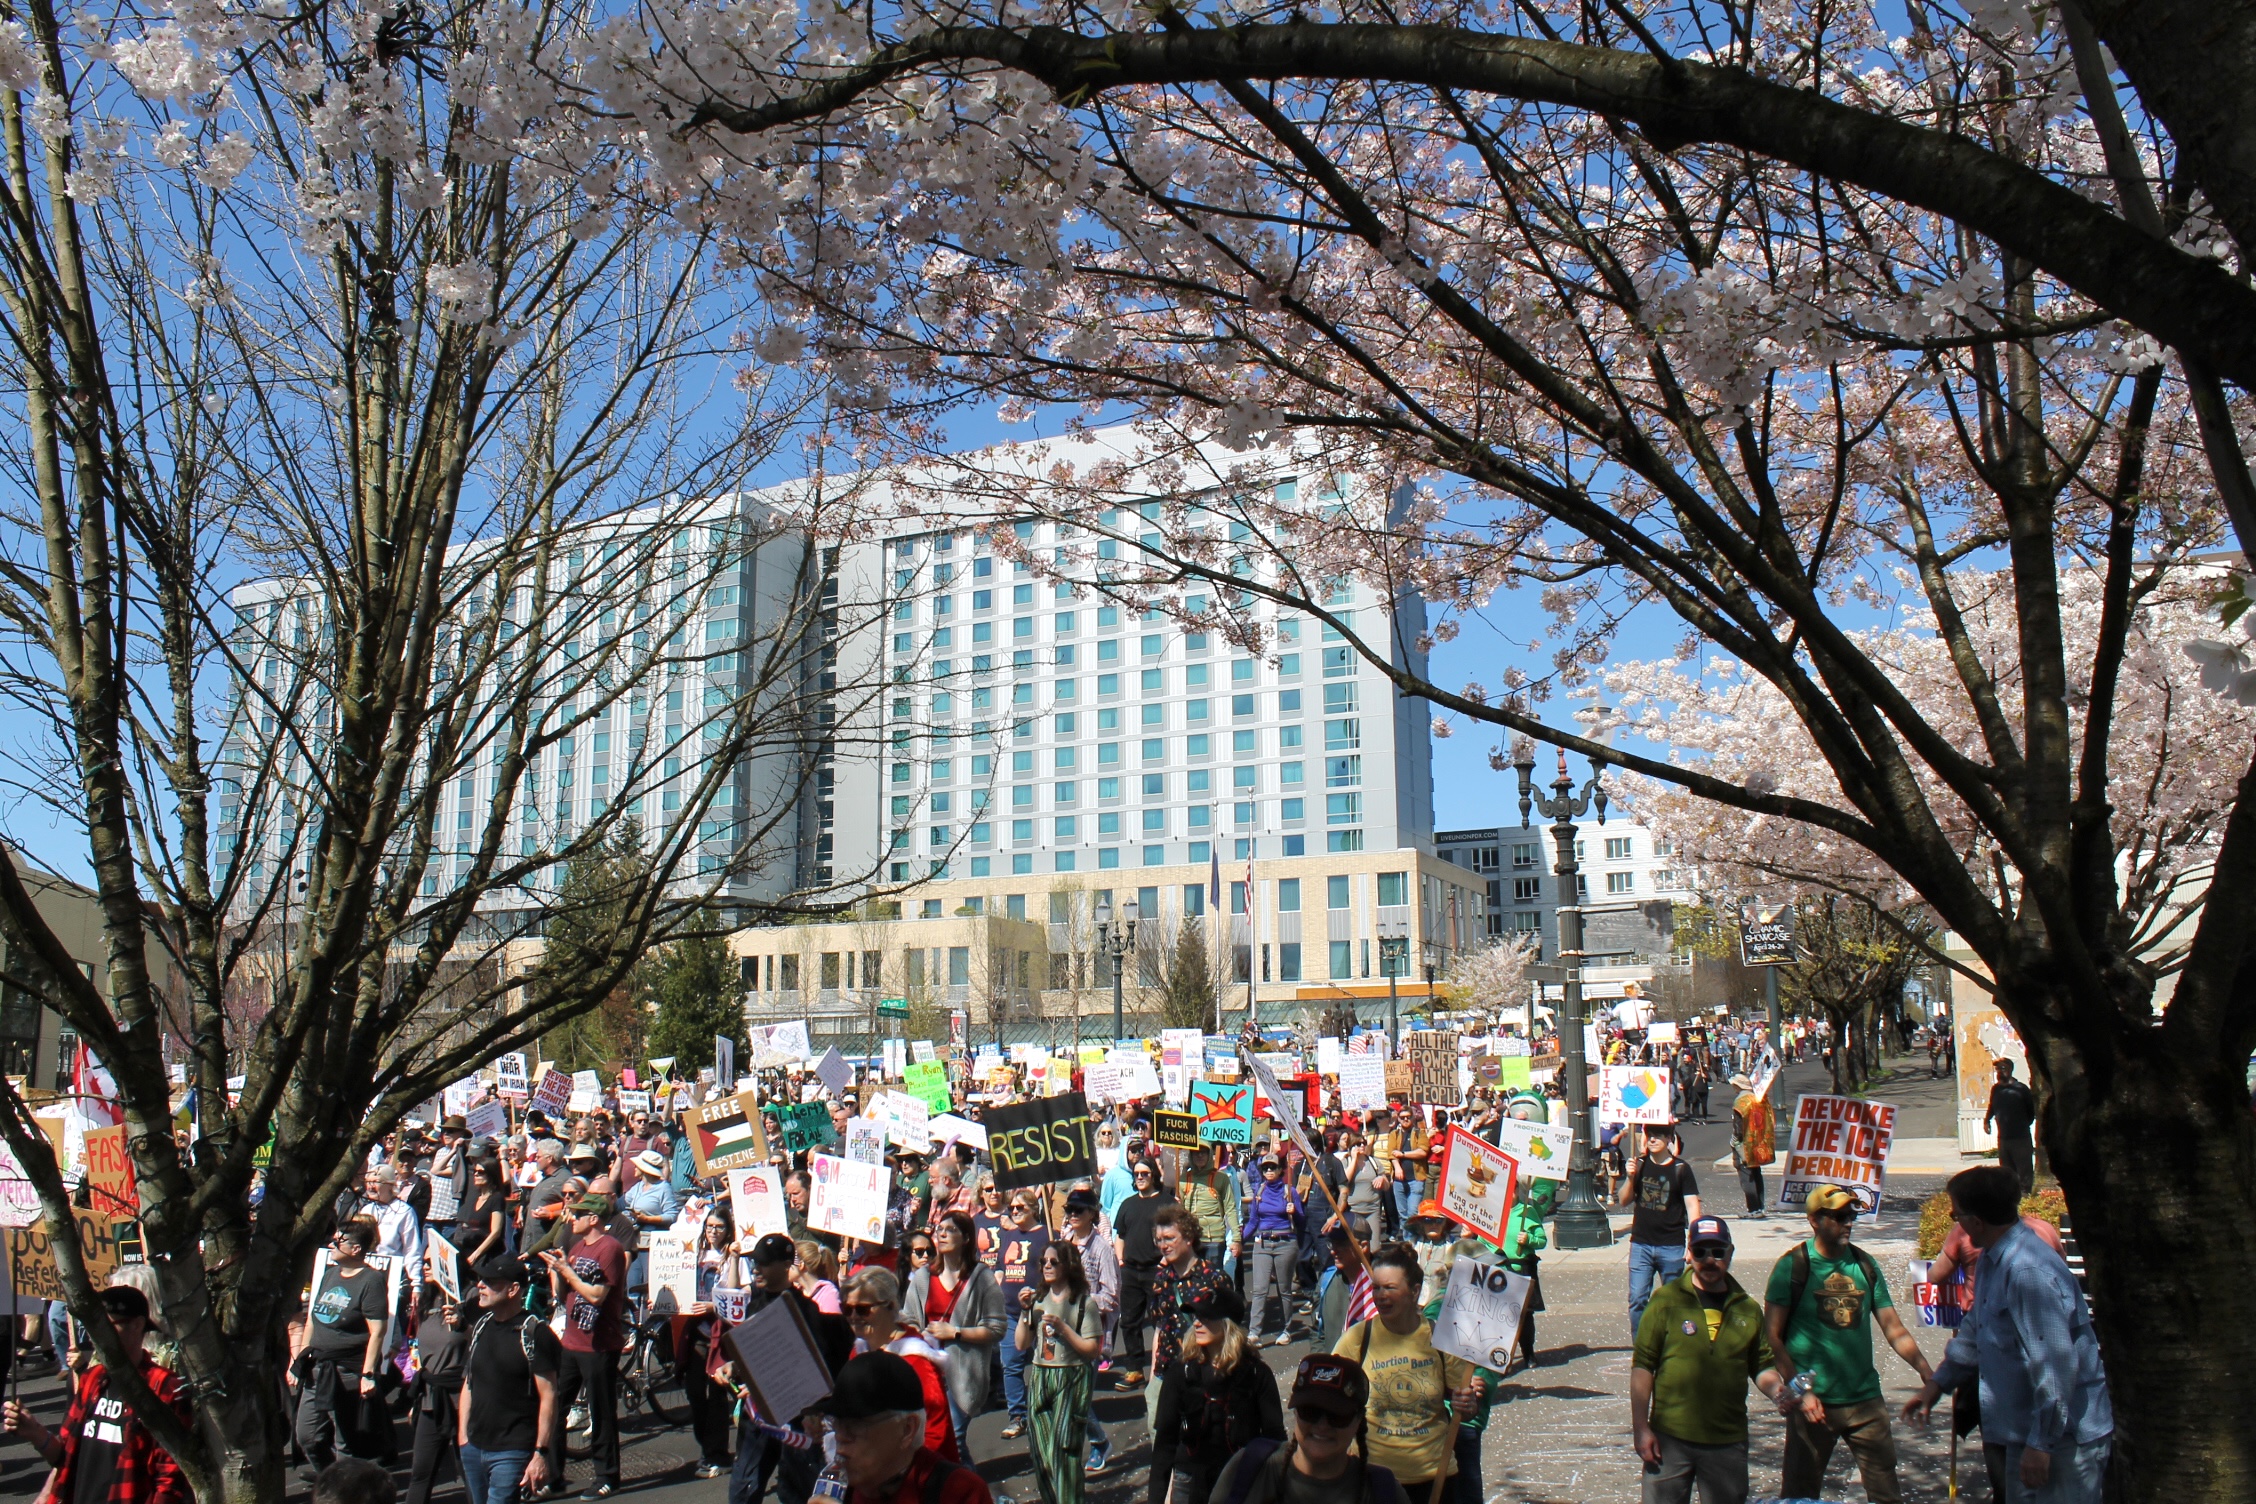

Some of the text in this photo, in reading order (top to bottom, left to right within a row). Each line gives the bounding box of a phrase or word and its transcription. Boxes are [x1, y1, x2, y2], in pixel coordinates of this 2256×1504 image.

[1441, 832, 1498, 841] LIVEUNIONPDX.COM
[1748, 924, 1785, 934] CAMIC
[1745, 932, 1791, 944] SHOWCASE
[1753, 943, 1768, 952] April
[1411, 1033, 1457, 1051] ALL THE
[1412, 1050, 1457, 1070] POWER
[501, 1061, 520, 1076] WAR
[922, 1065, 943, 1077] Ryan
[1386, 1065, 1398, 1074] AKE
[499, 1077, 526, 1089] ON IRAN
[546, 1069, 574, 1087] REVOKE
[1413, 1068, 1454, 1086] ALL THE
[542, 1077, 570, 1098] THE ICE
[1386, 1078, 1411, 1092] MERICA
[536, 1090, 565, 1108] PERMIT!
[1413, 1085, 1459, 1105] PEOPLE
[701, 1099, 741, 1123] FREE
[778, 1101, 826, 1122] Liberty
[1616, 1108, 1660, 1120] To Fall!
[1800, 1098, 1895, 1129] REVOKE
[782, 1119, 798, 1132] AND
[1165, 1118, 1189, 1130] FUCK
[1159, 1130, 1197, 1144] FASCISM
[1212, 1128, 1245, 1142] KINGS
[1554, 1132, 1571, 1140] FUCK
[1796, 1121, 1890, 1162] THE ICE
[989, 1115, 1090, 1173] RESIST
[706, 1147, 756, 1170] PALESTINE
[1455, 1133, 1509, 1171] Dump Trump
[1789, 1155, 1884, 1185] PERMIT!
[1786, 1182, 1802, 1192] ICE
[1448, 1189, 1495, 1221] King of the
[1453, 1201, 1496, 1233] Shit Show!
[656, 1237, 678, 1247] ANNE
[123, 1253, 137, 1262] NOW
[652, 1249, 681, 1260] FRANK
[655, 1263, 681, 1272] WROTE
[1004, 1269, 1027, 1277] MARCH
[1470, 1262, 1508, 1293] NO
[1825, 1282, 1854, 1291] RESIST
[1371, 1355, 1434, 1371] Abortion Bans
[1376, 1426, 1393, 1434] Into
[1395, 1427, 1411, 1436] the
